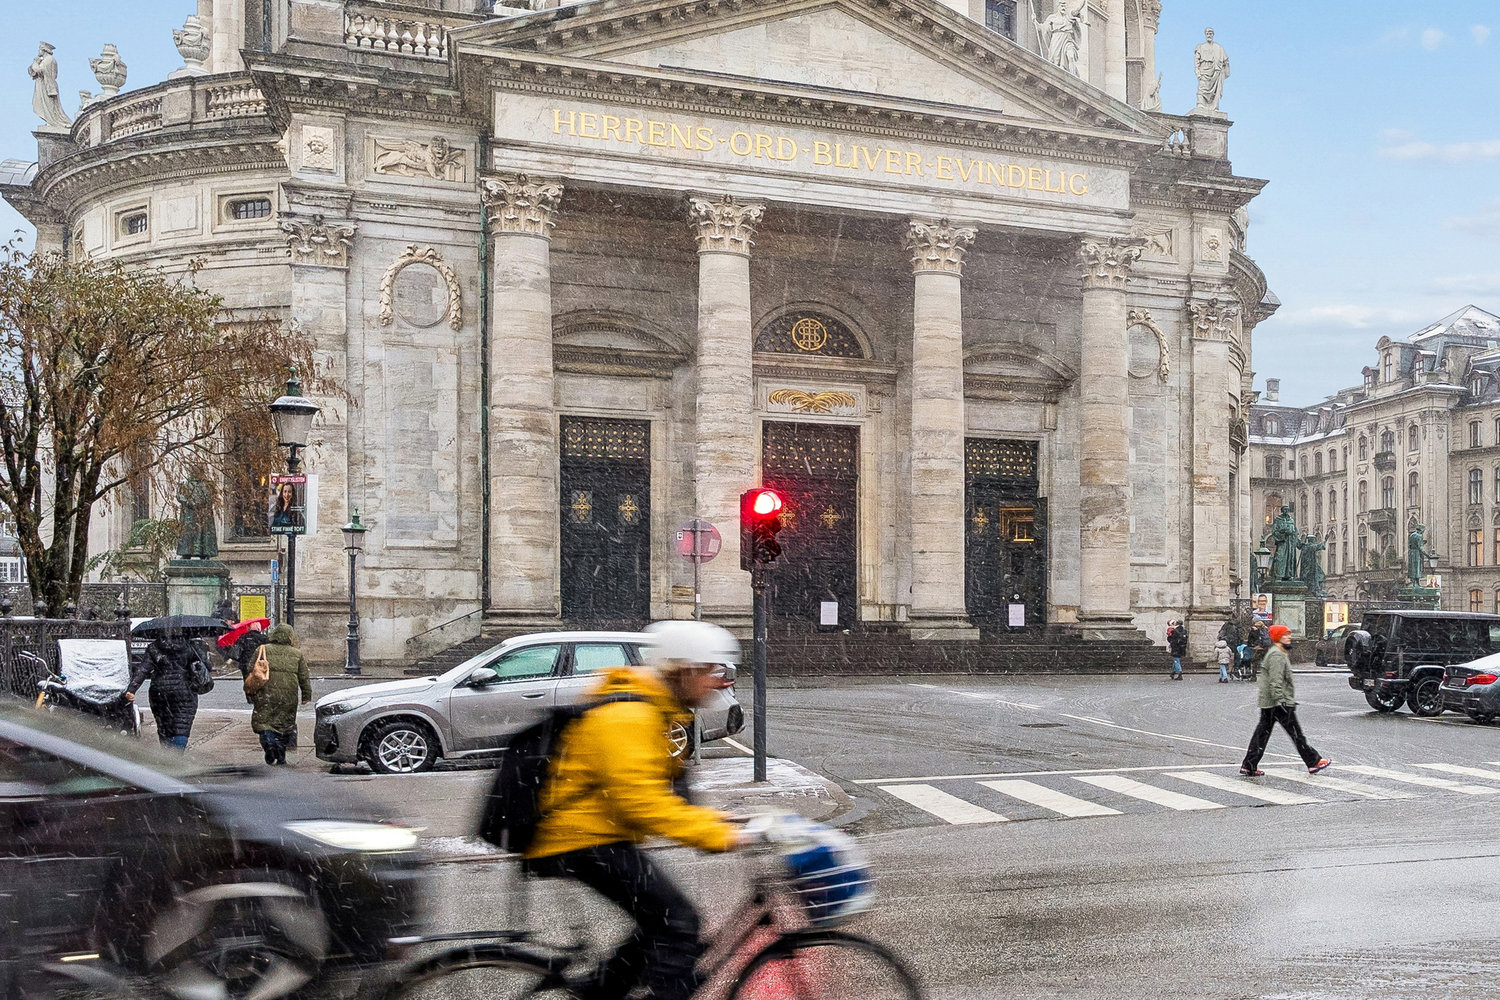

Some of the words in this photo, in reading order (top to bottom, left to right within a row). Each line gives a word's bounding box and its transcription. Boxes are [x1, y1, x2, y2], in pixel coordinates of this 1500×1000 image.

[552, 108, 714, 151] HERRENS
[729, 131, 798, 161] ORD
[812, 140, 924, 177] BLIVER
[935, 154, 1089, 196] EVINDELIG
